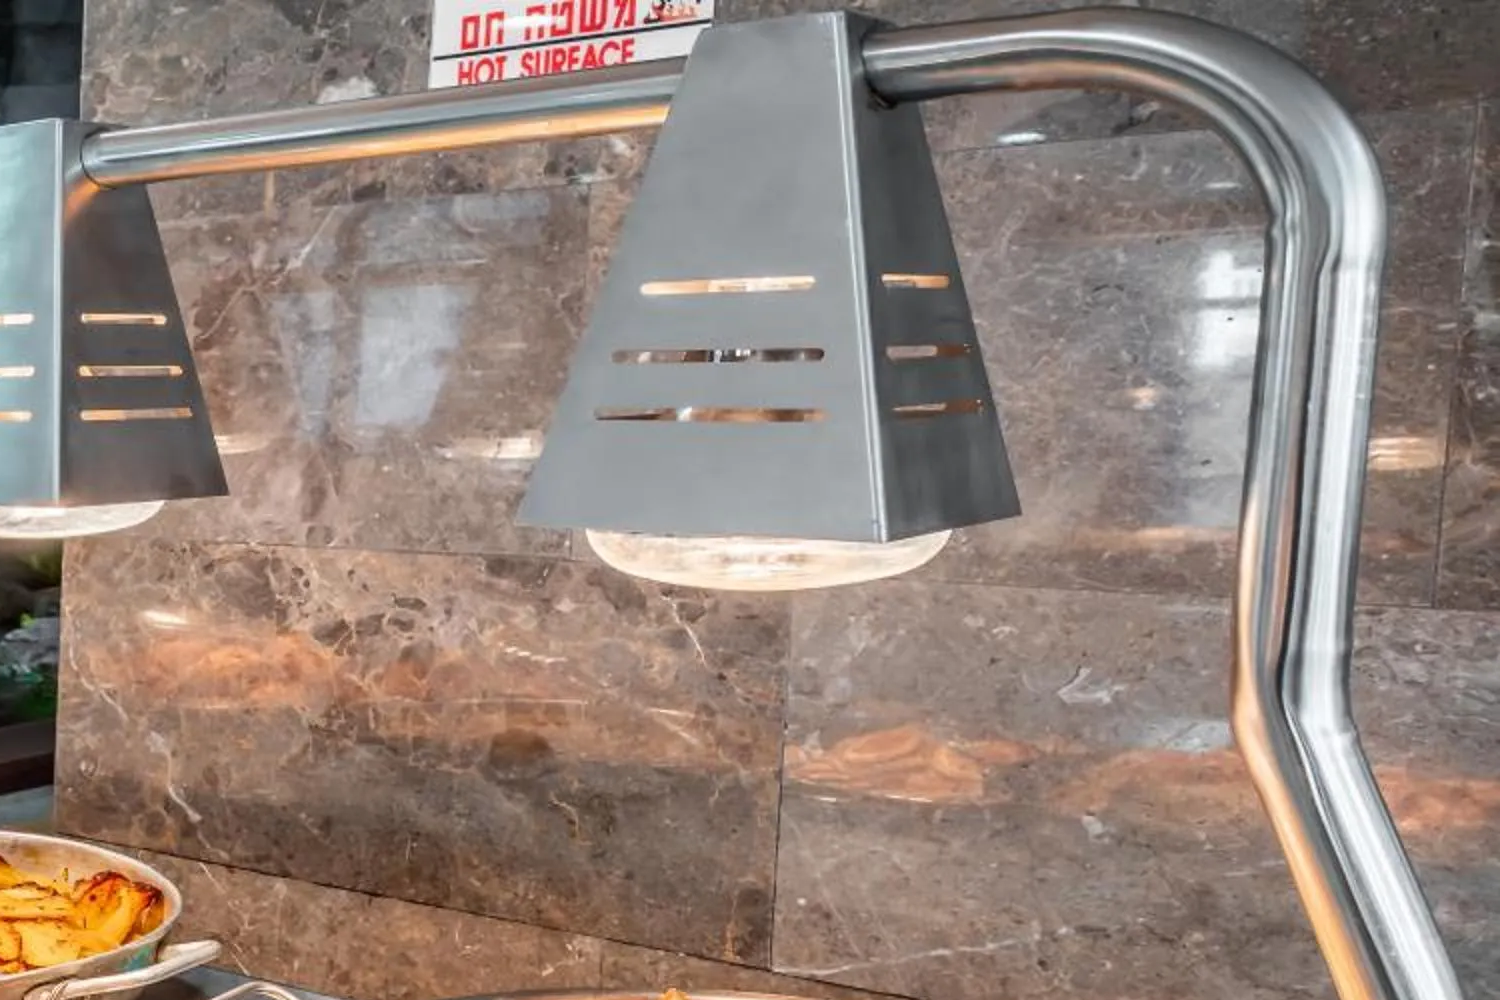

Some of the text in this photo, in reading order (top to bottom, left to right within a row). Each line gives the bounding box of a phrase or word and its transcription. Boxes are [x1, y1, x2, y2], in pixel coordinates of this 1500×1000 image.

[460, 10, 504, 50] חם
[457, 38, 635, 86] HOT SURFACE
